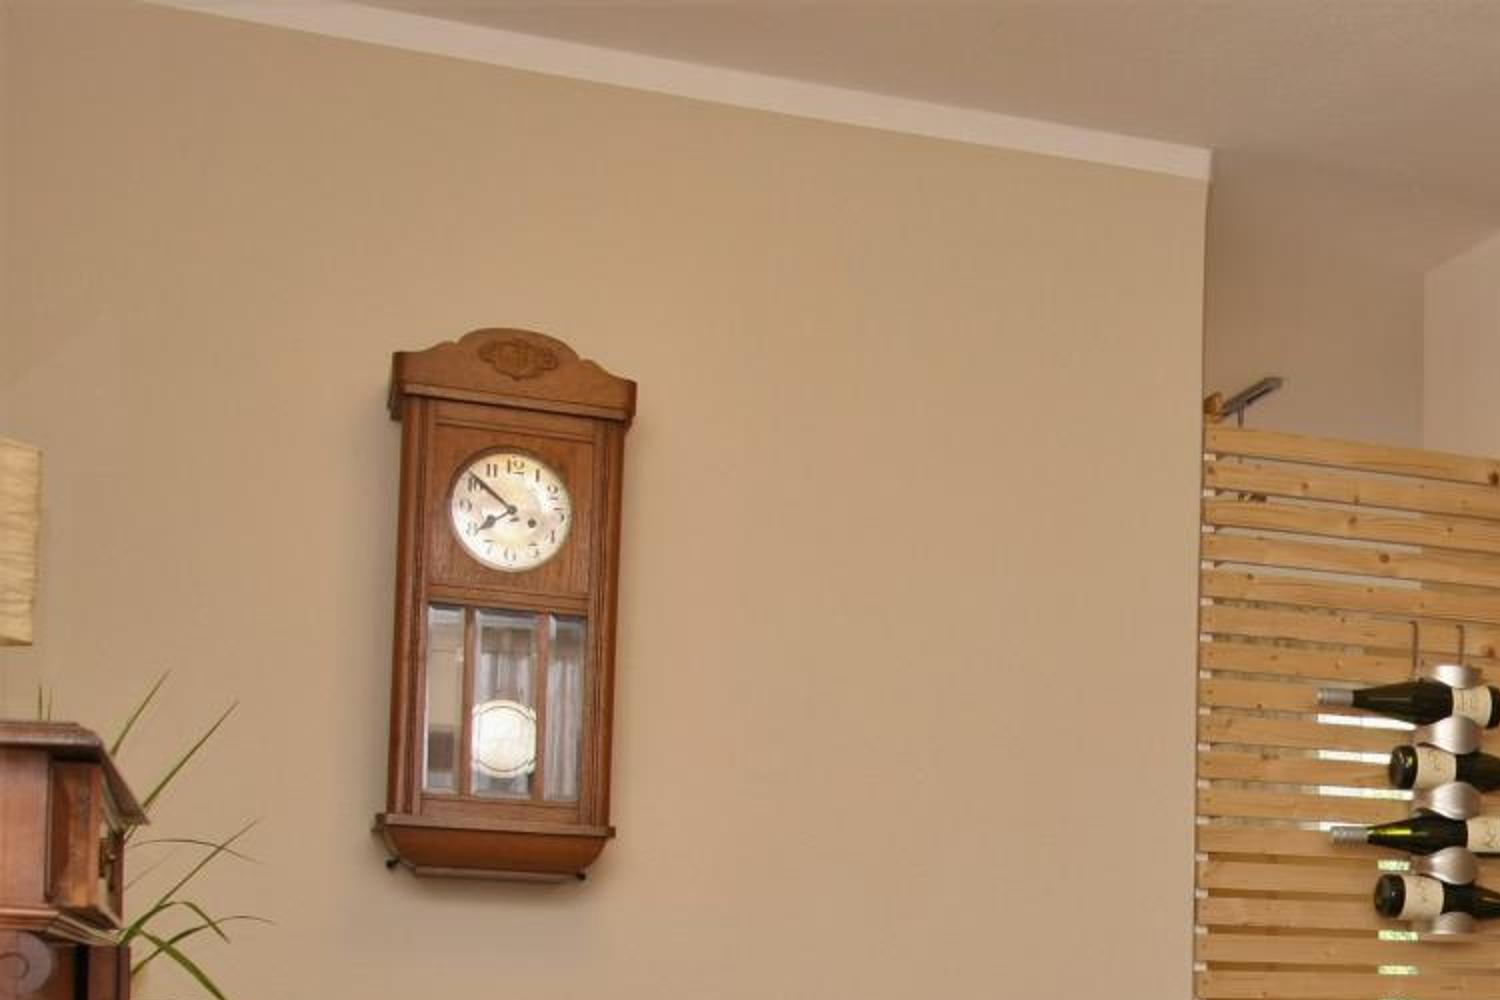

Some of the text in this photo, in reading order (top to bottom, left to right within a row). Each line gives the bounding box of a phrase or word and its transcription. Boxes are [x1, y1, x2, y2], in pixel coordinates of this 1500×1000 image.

[486, 463, 498, 478] 11
[506, 458, 525, 475] 12
[547, 484, 559, 501] 2
[458, 498, 472, 513] 9
[552, 507, 566, 523] 3
[465, 522, 480, 537] 8
[482, 538, 496, 556] 7
[503, 546, 517, 562] 6
[527, 542, 541, 559] 5
